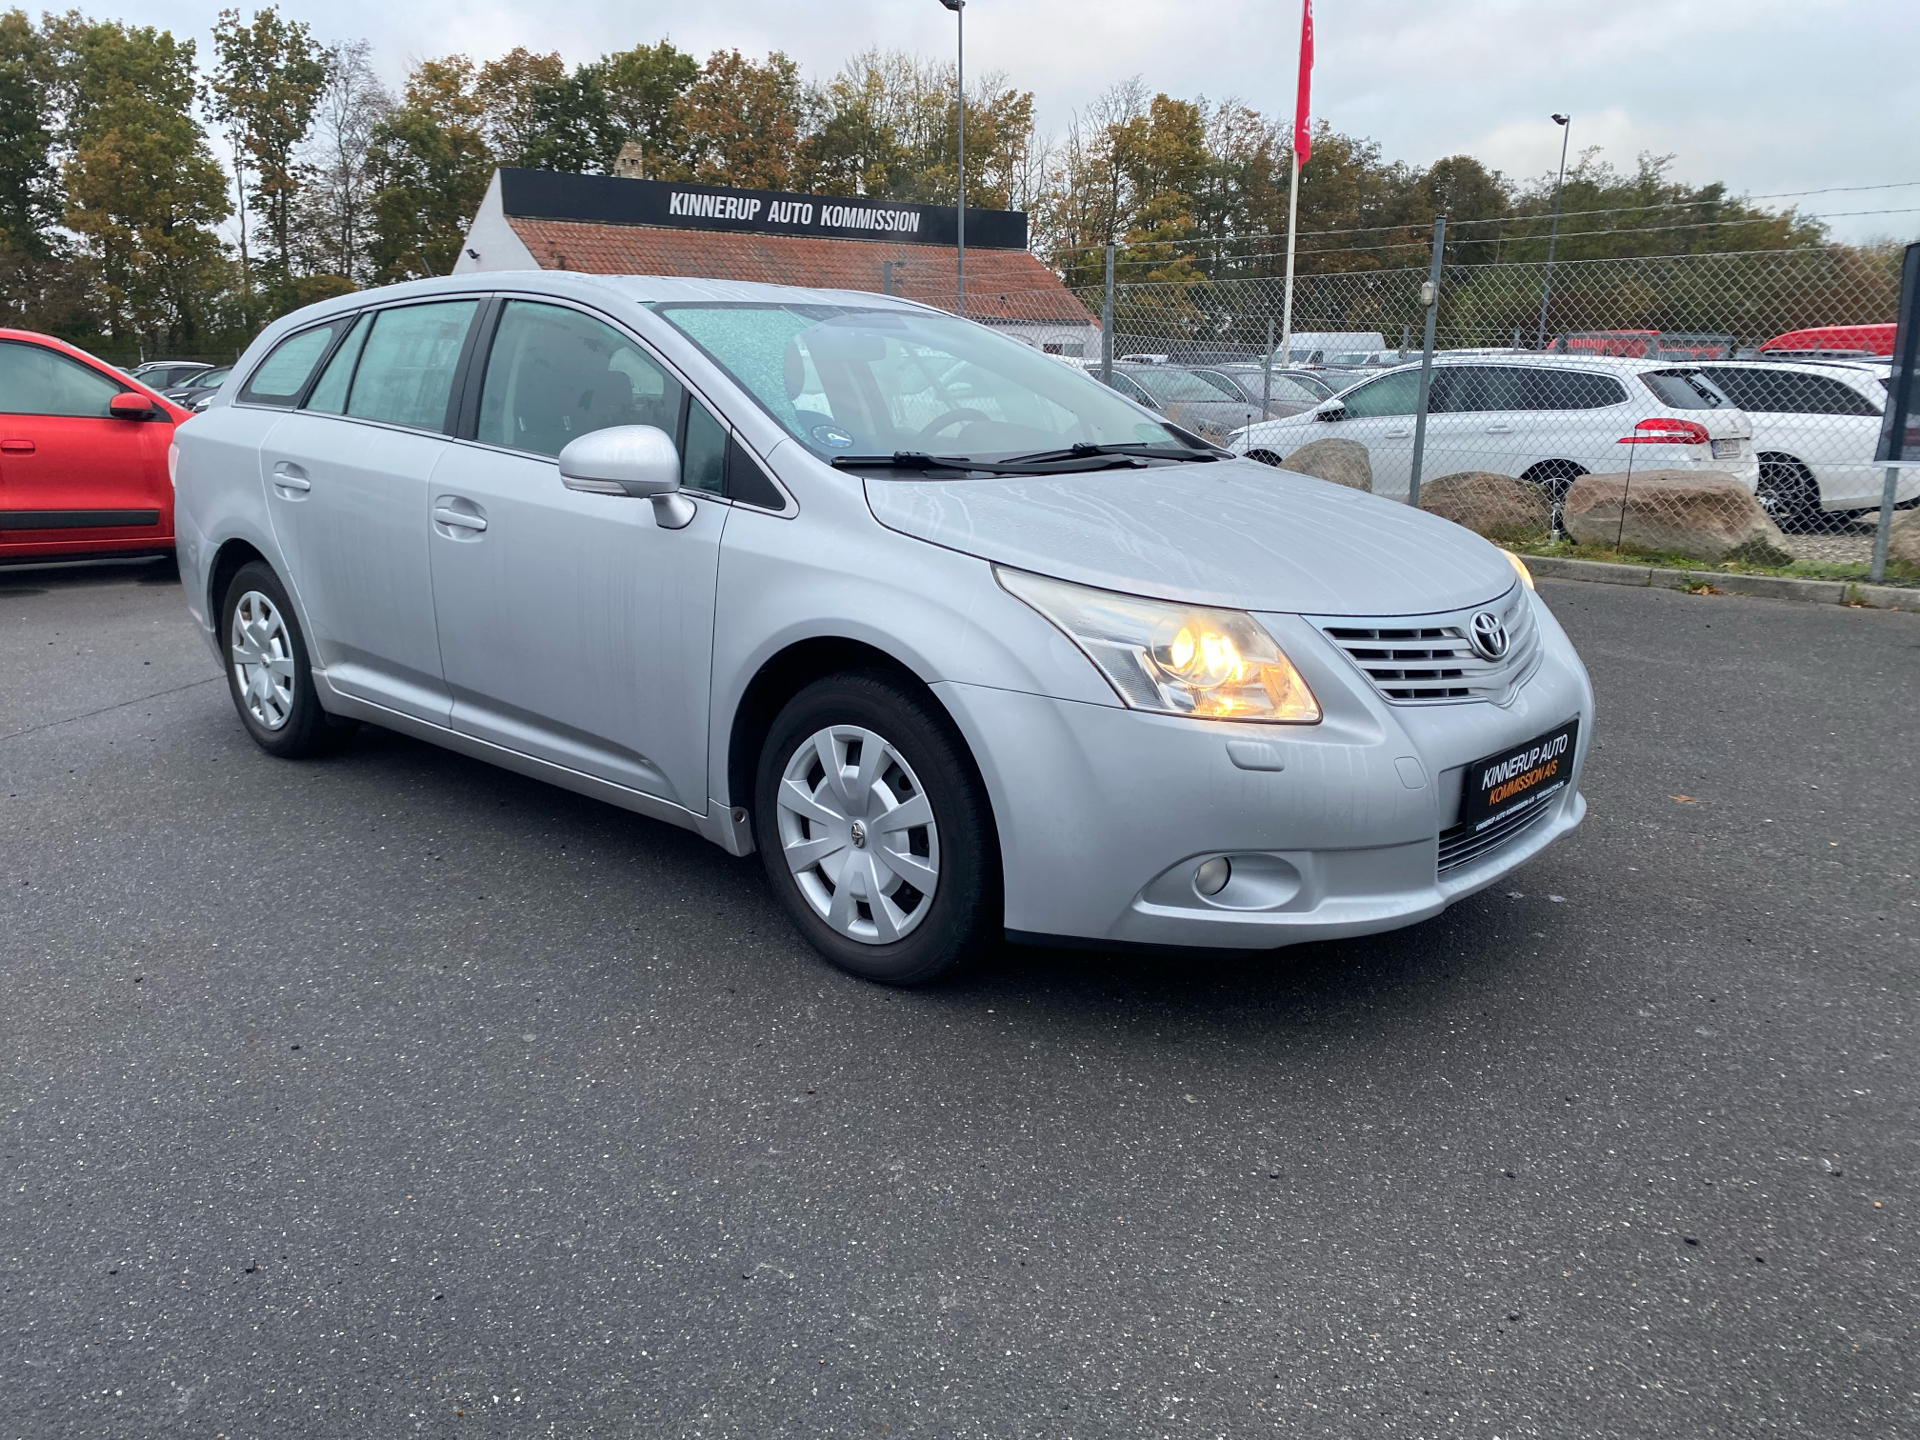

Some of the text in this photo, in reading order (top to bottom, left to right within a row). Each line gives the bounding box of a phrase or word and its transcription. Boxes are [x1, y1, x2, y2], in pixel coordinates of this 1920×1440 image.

[669, 192, 920, 233] KINNERUP AUTO KOMMISSION
[1482, 747, 1540, 791] KINNERUP
[1539, 733, 1568, 764] AUTO
[1489, 766, 1545, 806] KOMMISSION
[1543, 759, 1558, 780] A/S
